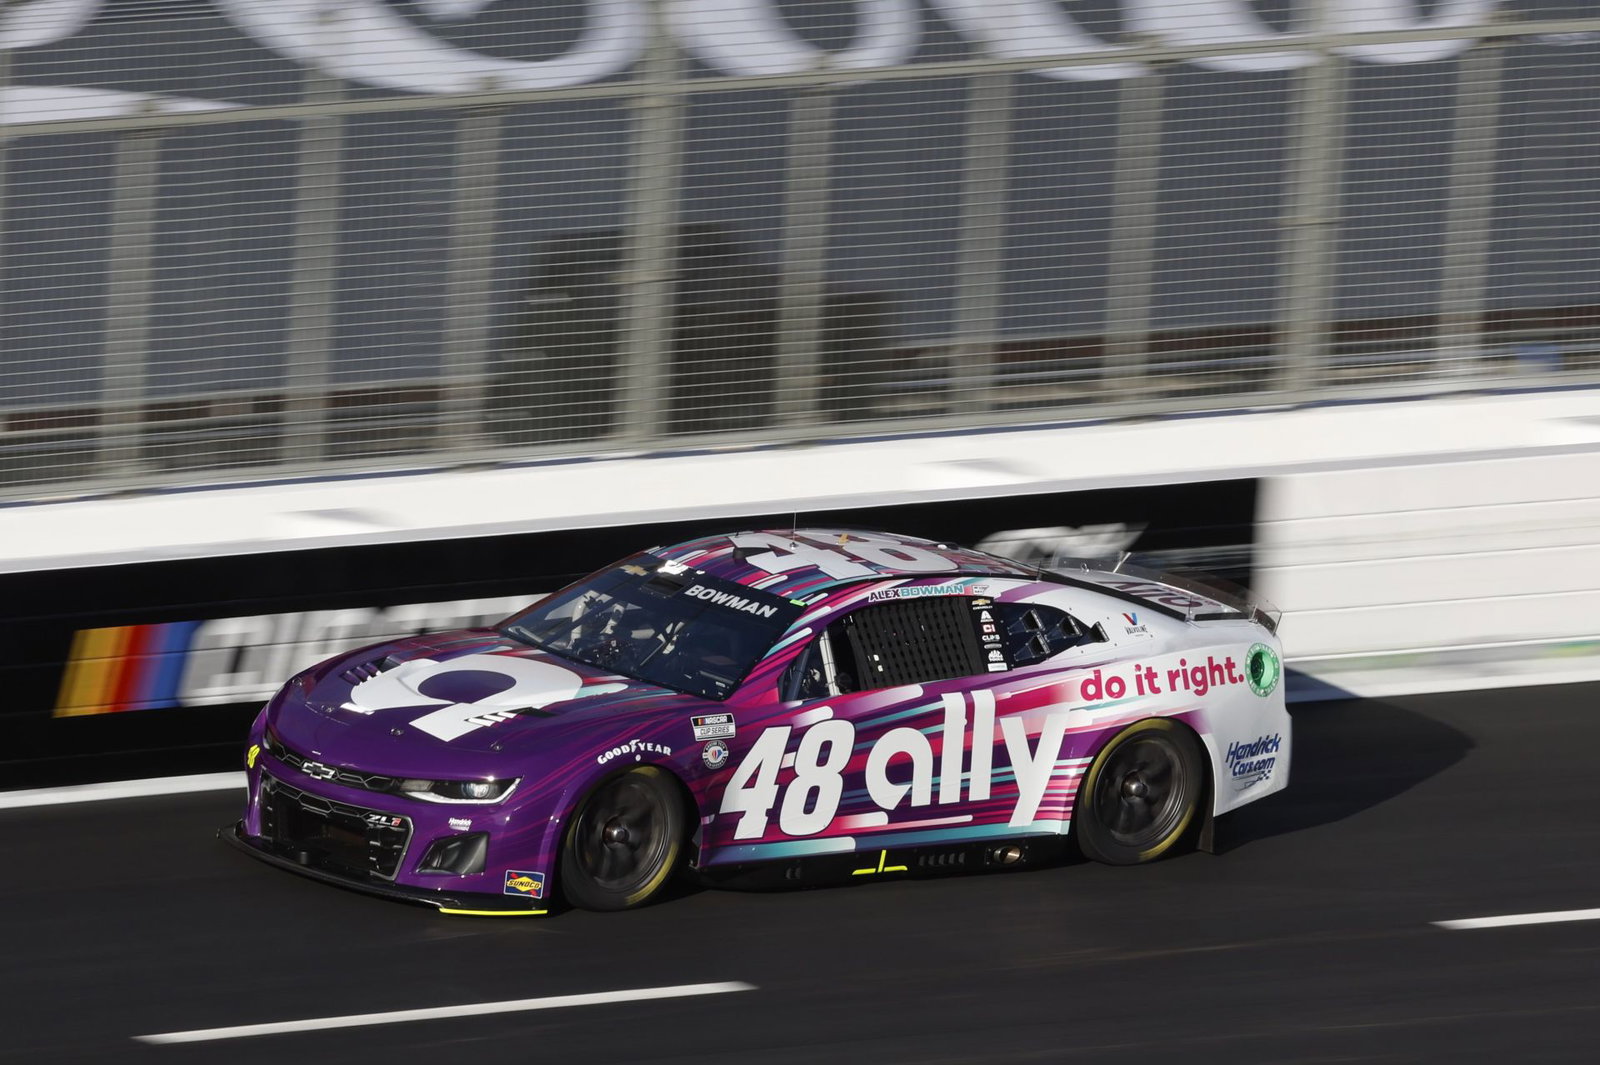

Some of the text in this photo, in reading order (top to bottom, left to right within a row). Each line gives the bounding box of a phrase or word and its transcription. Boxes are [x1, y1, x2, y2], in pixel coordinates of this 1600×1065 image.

[684, 584, 778, 619] BOWMAN
[1080, 669, 1126, 701] do
[1135, 663, 1161, 696] it
[1167, 656, 1245, 697] right.
[705, 715, 728, 724] NASCAR
[711, 726, 730, 734] SERIES
[865, 688, 1072, 829] ally
[1225, 733, 1282, 769] Hendrick
[719, 718, 856, 841] 48
[507, 879, 541, 890] SUNOCO
